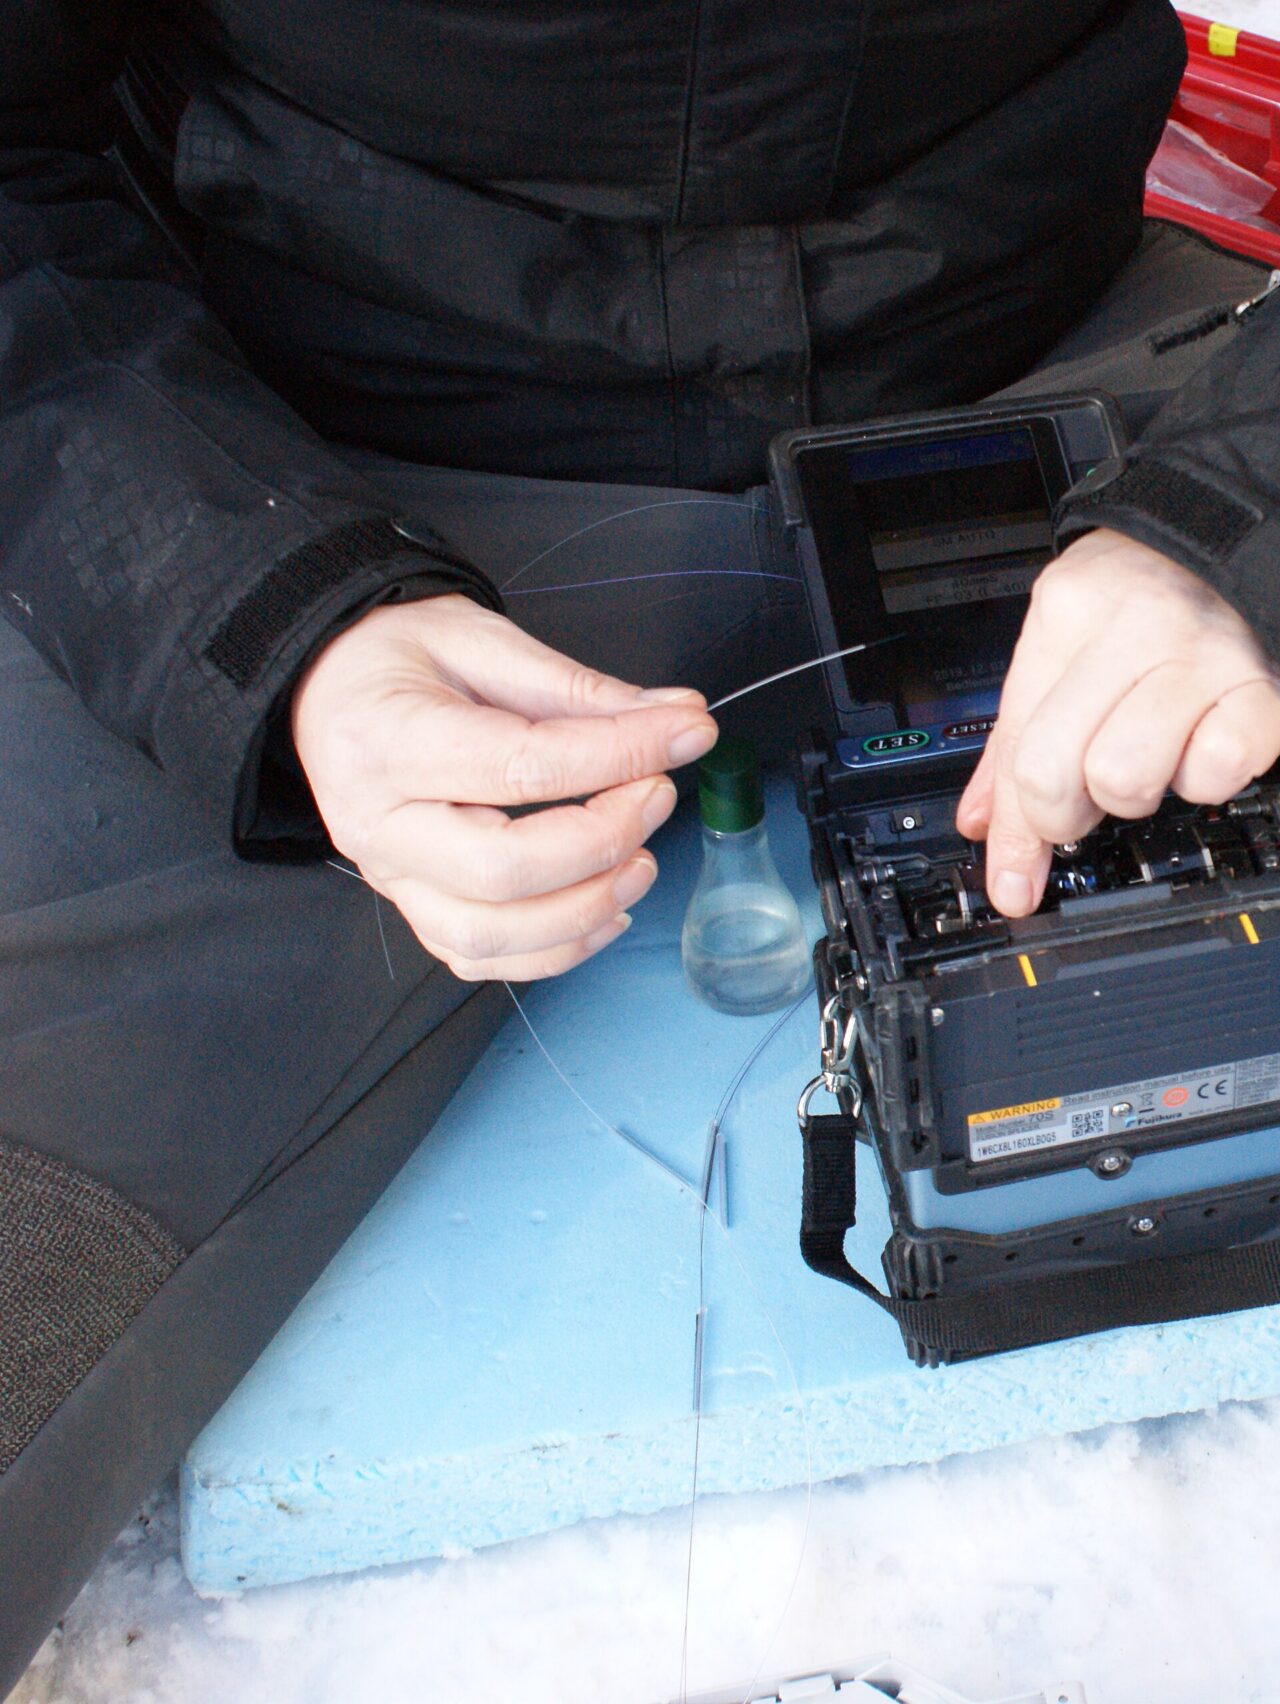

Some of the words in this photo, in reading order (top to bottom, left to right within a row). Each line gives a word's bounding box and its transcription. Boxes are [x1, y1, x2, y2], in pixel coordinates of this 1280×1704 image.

[957, 529, 996, 543] AUTO
[874, 734, 919, 751] SET
[1063, 1093, 1090, 1105] Read
[1144, 1075, 1179, 1090] manual
[1181, 1069, 1212, 1082] before
[990, 1099, 1057, 1120] WARNING
[1028, 1110, 1055, 1123] 70S
[1138, 1111, 1182, 1126] Fujikura
